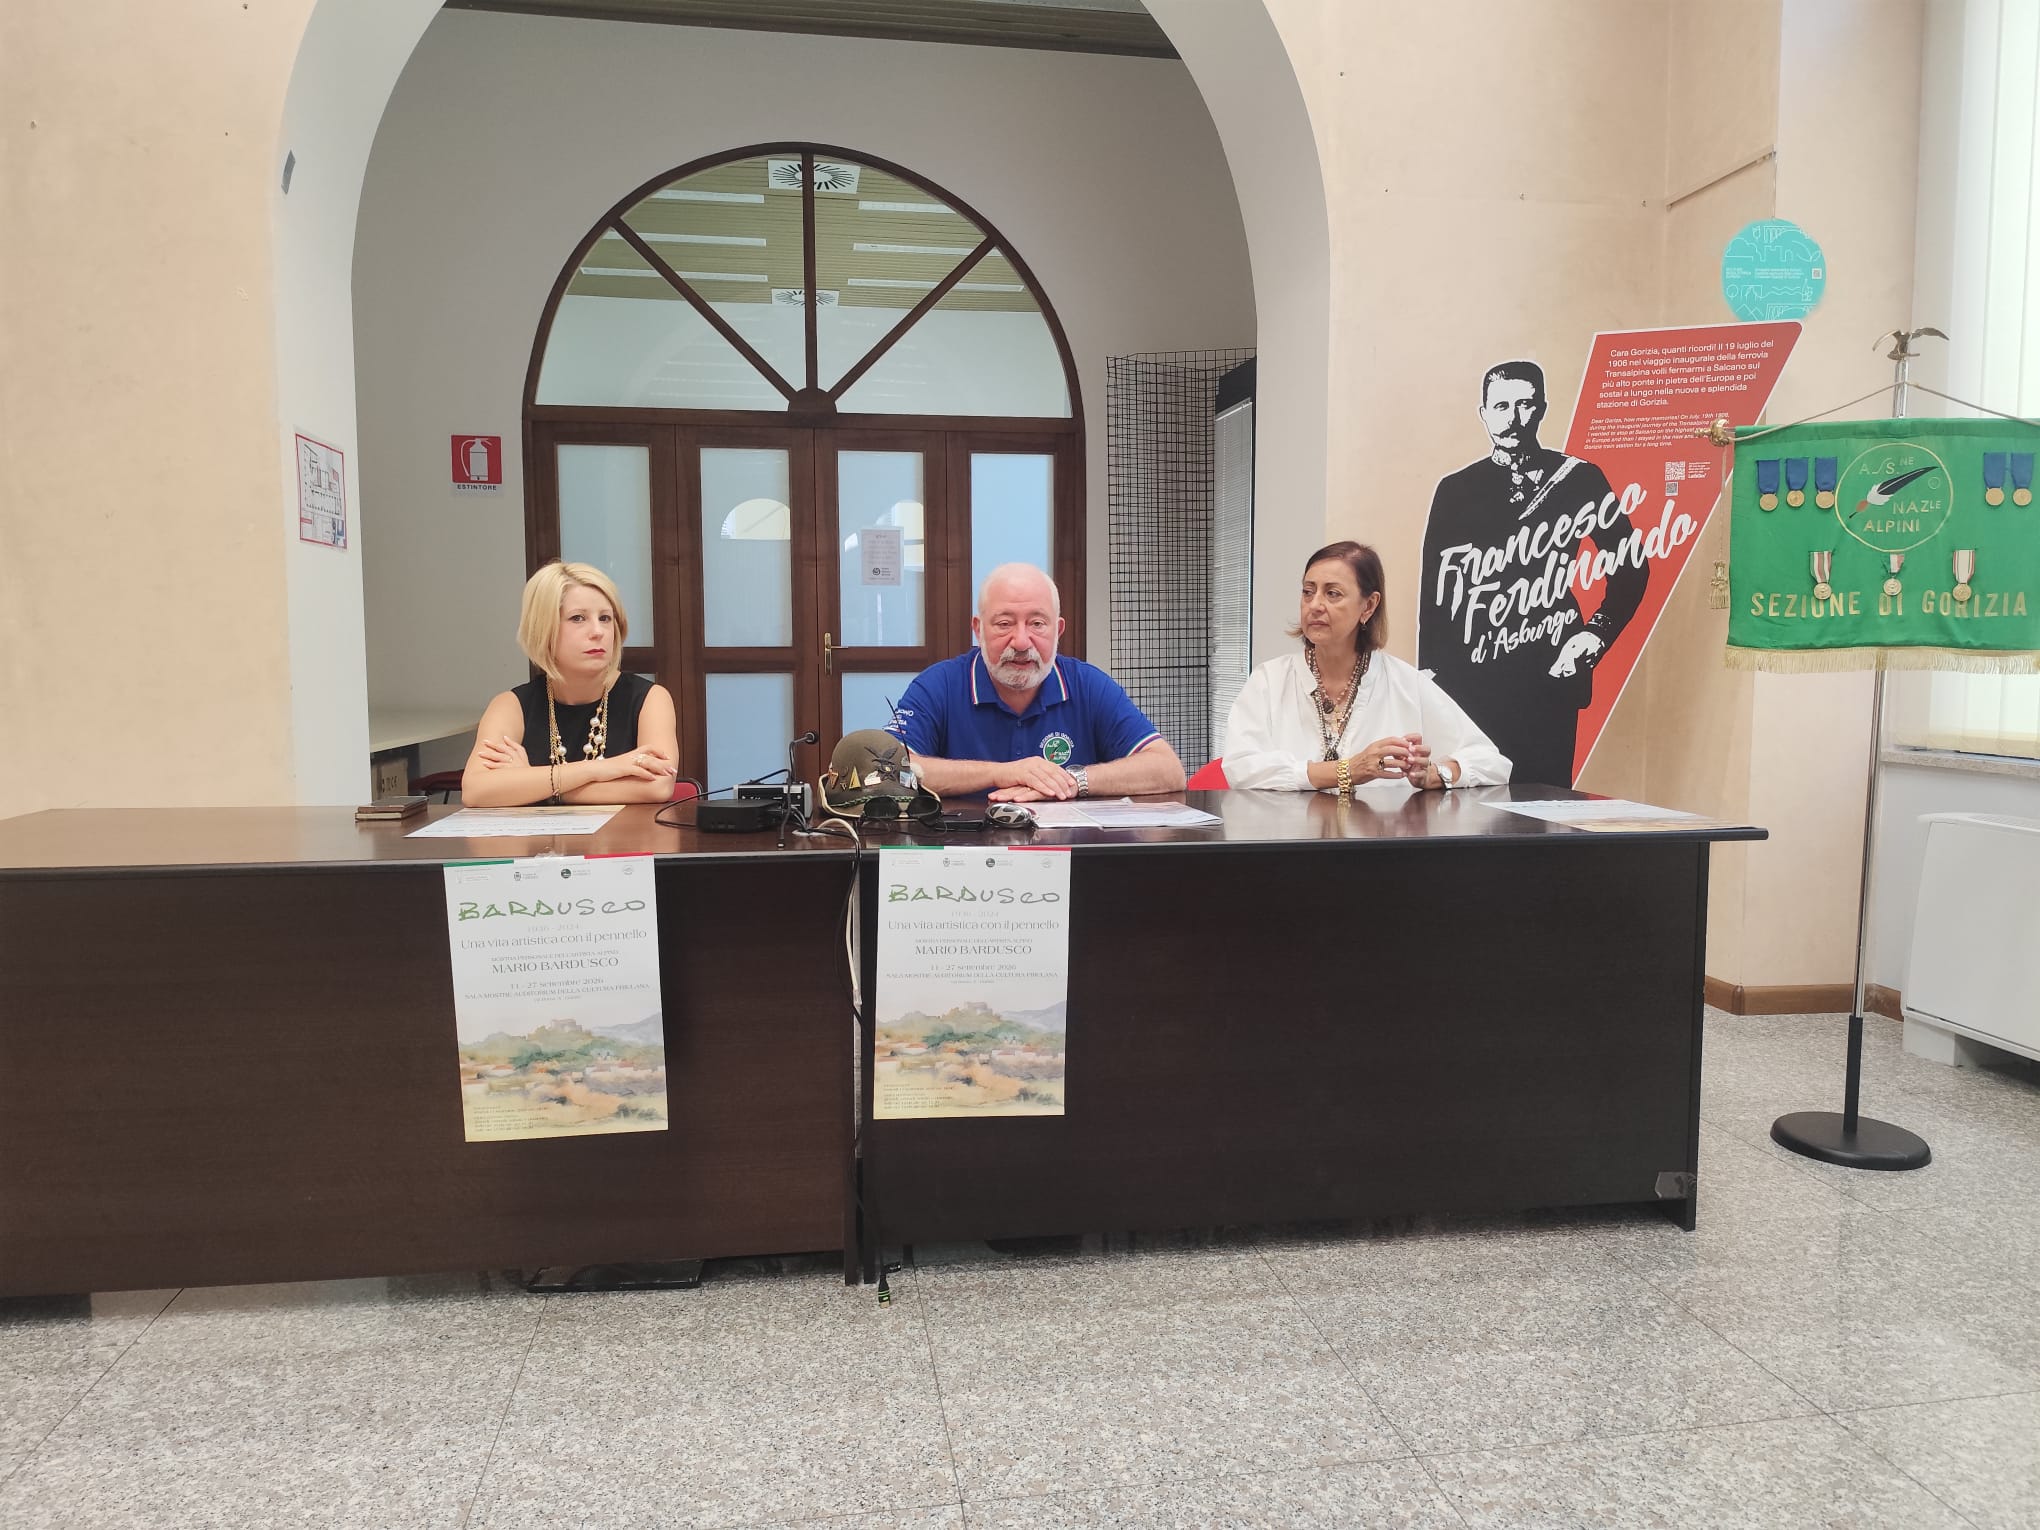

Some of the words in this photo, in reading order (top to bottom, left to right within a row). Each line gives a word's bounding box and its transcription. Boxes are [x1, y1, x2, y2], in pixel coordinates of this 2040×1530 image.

[1610, 349, 1629, 358] Cara
[1630, 347, 1660, 357] Gorizia,
[1661, 345, 1687, 356] quanti
[1725, 342, 1736, 350] 19
[1737, 340, 1760, 351] luglio
[1760, 339, 1774, 349] del
[1608, 359, 1628, 368] 1906
[1629, 358, 1642, 367] nel
[1642, 357, 1671, 367] viaggio
[1672, 354, 1716, 366] inaugurale
[1716, 352, 1736, 361] della
[1738, 350, 1769, 360] ferrovia
[1604, 368, 1650, 378] Transalpina
[1651, 367, 1667, 376] volli
[1668, 365, 1705, 375] fermarmi
[1713, 363, 1747, 372] Salcano
[1602, 380, 1615, 390] più
[1616, 379, 1631, 388] alto
[1632, 379, 1655, 388] ponte
[1656, 377, 1664, 385] in
[1665, 375, 1688, 387] pietra
[1689, 373, 1735, 384] dell'Europa
[1743, 372, 1757, 382] poi
[1599, 390, 1623, 399] sostai
[1630, 389, 1653, 399] lungo
[1654, 387, 1674, 396] nella
[1675, 386, 1700, 395] nuova
[1707, 383, 1748, 394] splendida
[1596, 400, 1630, 409] stazione
[1630, 399, 1638, 408] di
[1639, 397, 1668, 407] Gorizia.
[1863, 519, 1920, 534] ALPINI
[1436, 481, 1648, 621] Francesco
[1463, 498, 1698, 645] Ferdinando
[1751, 591, 1861, 618] SEZIONE
[1879, 591, 1904, 617] DI
[1922, 590, 2028, 617] GORIZIA
[1470, 607, 1578, 665] d'Asburgo
[888, 884, 1060, 904] BARDUSCO
[458, 898, 646, 921] BARDUSCO
[888, 919, 912, 930] Una
[912, 919, 934, 930] vita
[935, 919, 979, 930] artistica
[980, 920, 1003, 930] con
[1003, 919, 1011, 930] il
[1011, 919, 1060, 932] pennello
[460, 938, 487, 950] Una
[488, 936, 510, 949] vita
[511, 934, 558, 947] artistica
[560, 933, 583, 944] con
[584, 931, 593, 943] il
[594, 928, 648, 946] pennello
[915, 945, 957, 955] MARIO
[960, 945, 1032, 955] BARDUSCO
[491, 961, 538, 975] MARIO
[540, 957, 620, 972] BARDUSCO
